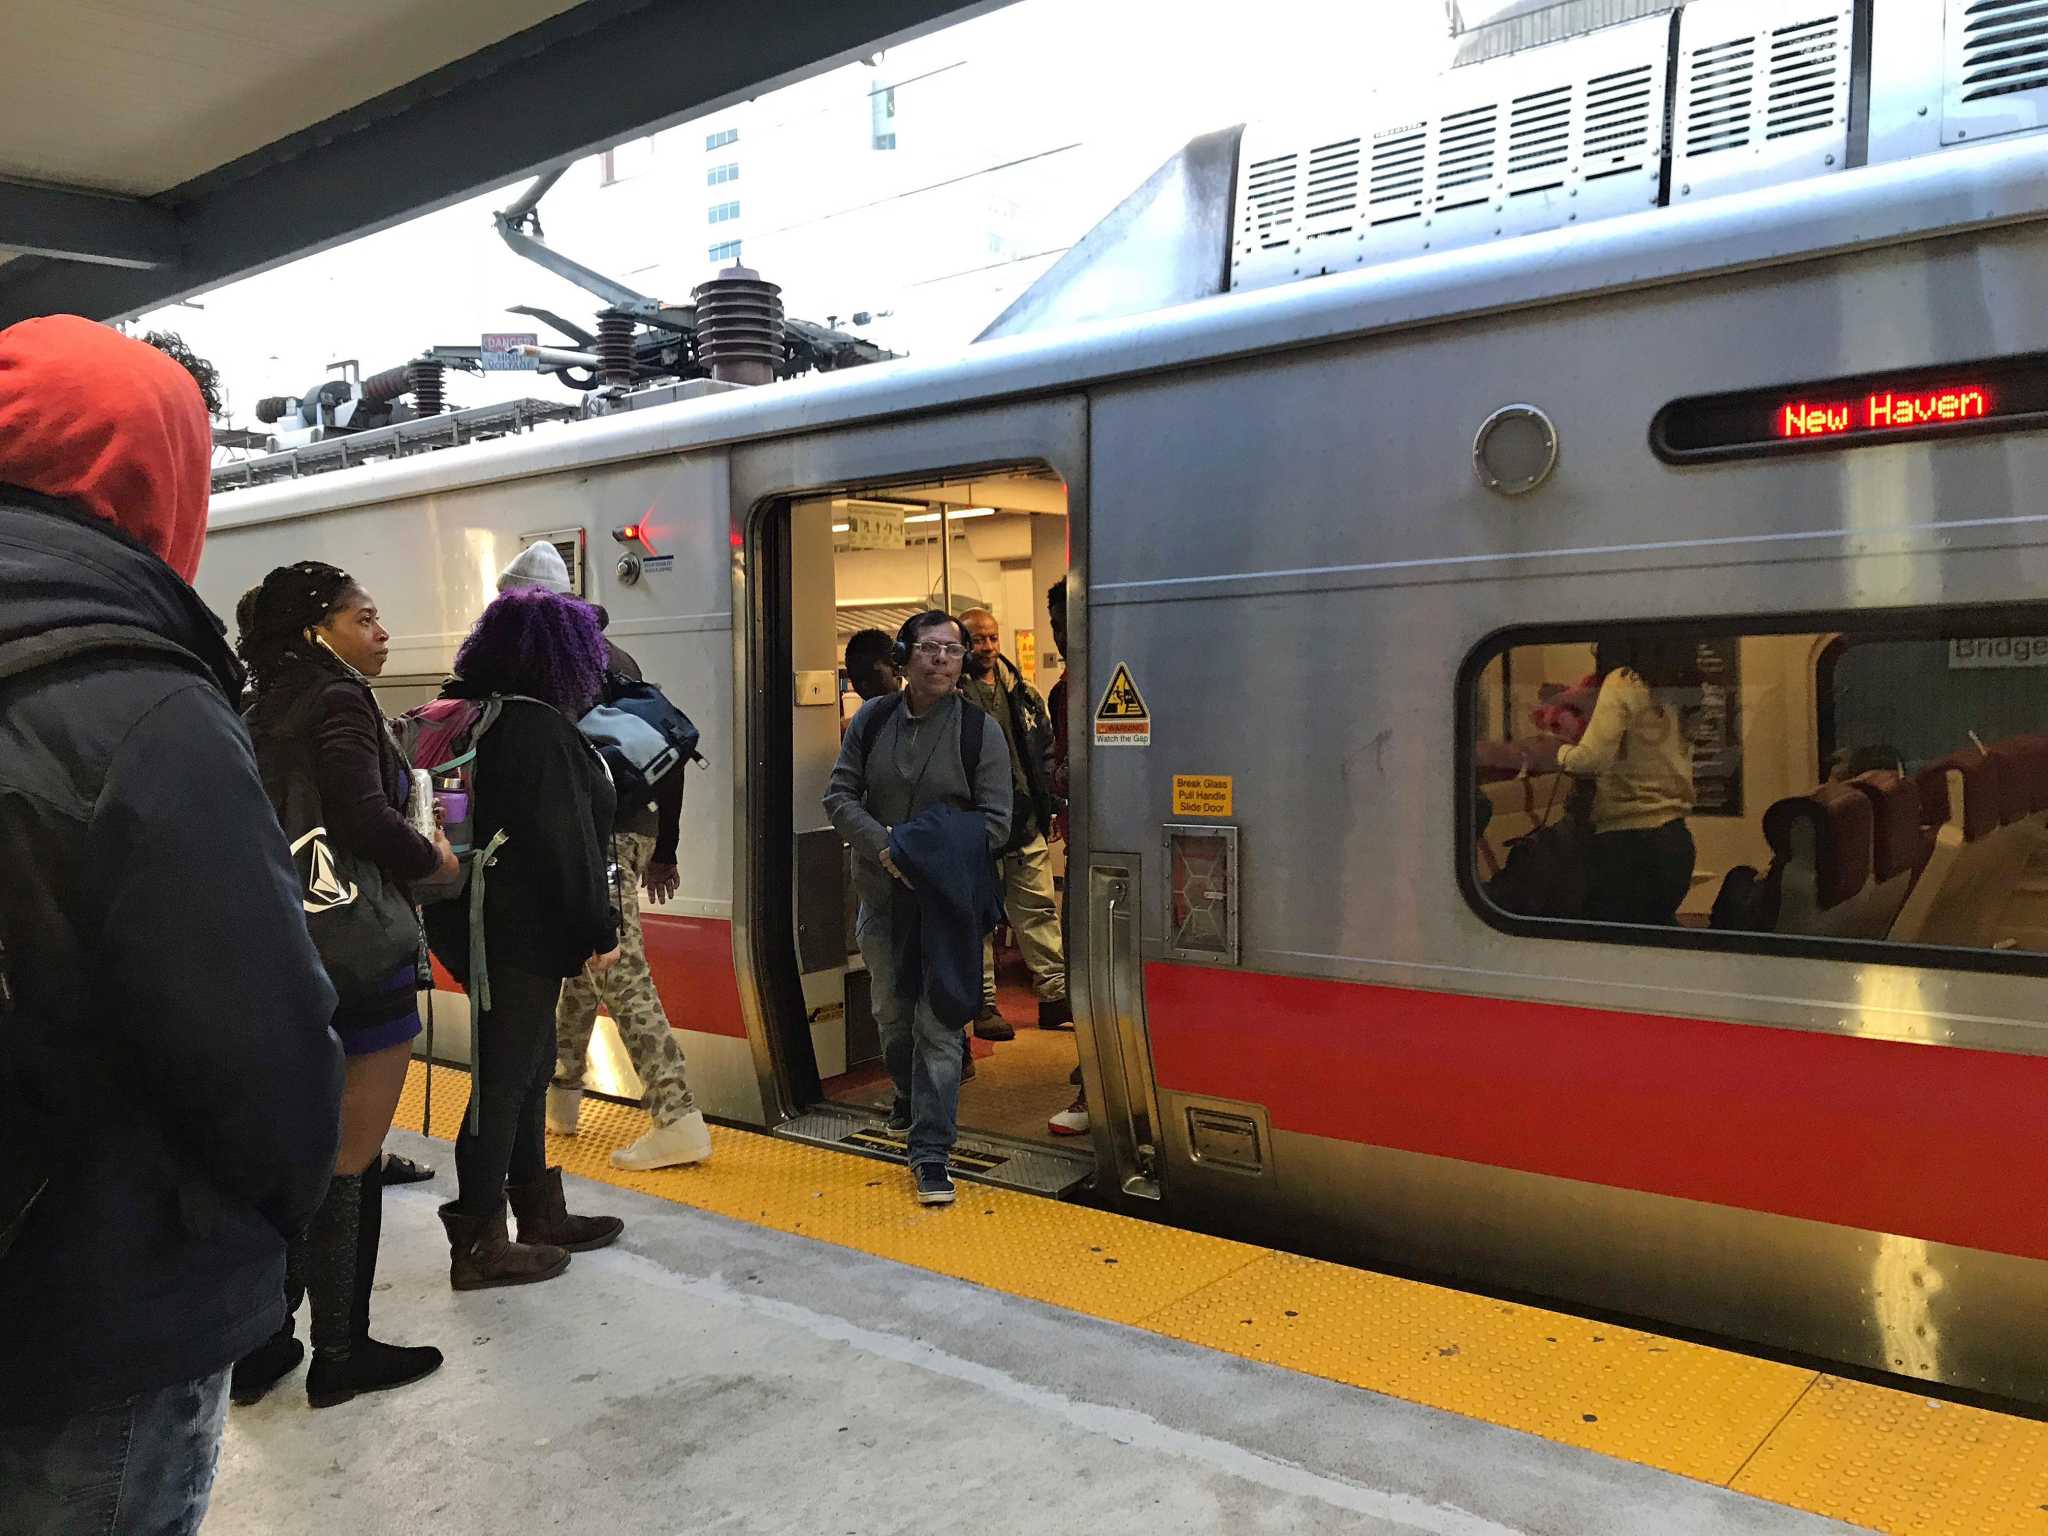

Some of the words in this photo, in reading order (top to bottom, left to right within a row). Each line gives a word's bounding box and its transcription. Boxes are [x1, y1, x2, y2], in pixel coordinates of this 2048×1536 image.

[1784, 404, 1848, 436] New
[1869, 391, 1984, 427] Haven
[1097, 735, 1119, 743] Watch
[1133, 735, 1149, 744] Gap
[1177, 778, 1200, 788] Break
[1203, 779, 1228, 789] Glass
[1178, 790, 1195, 800] Pull
[1197, 790, 1226, 800] Handle
[1180, 801, 1201, 812] Slide
[1203, 803, 1224, 812] Door
